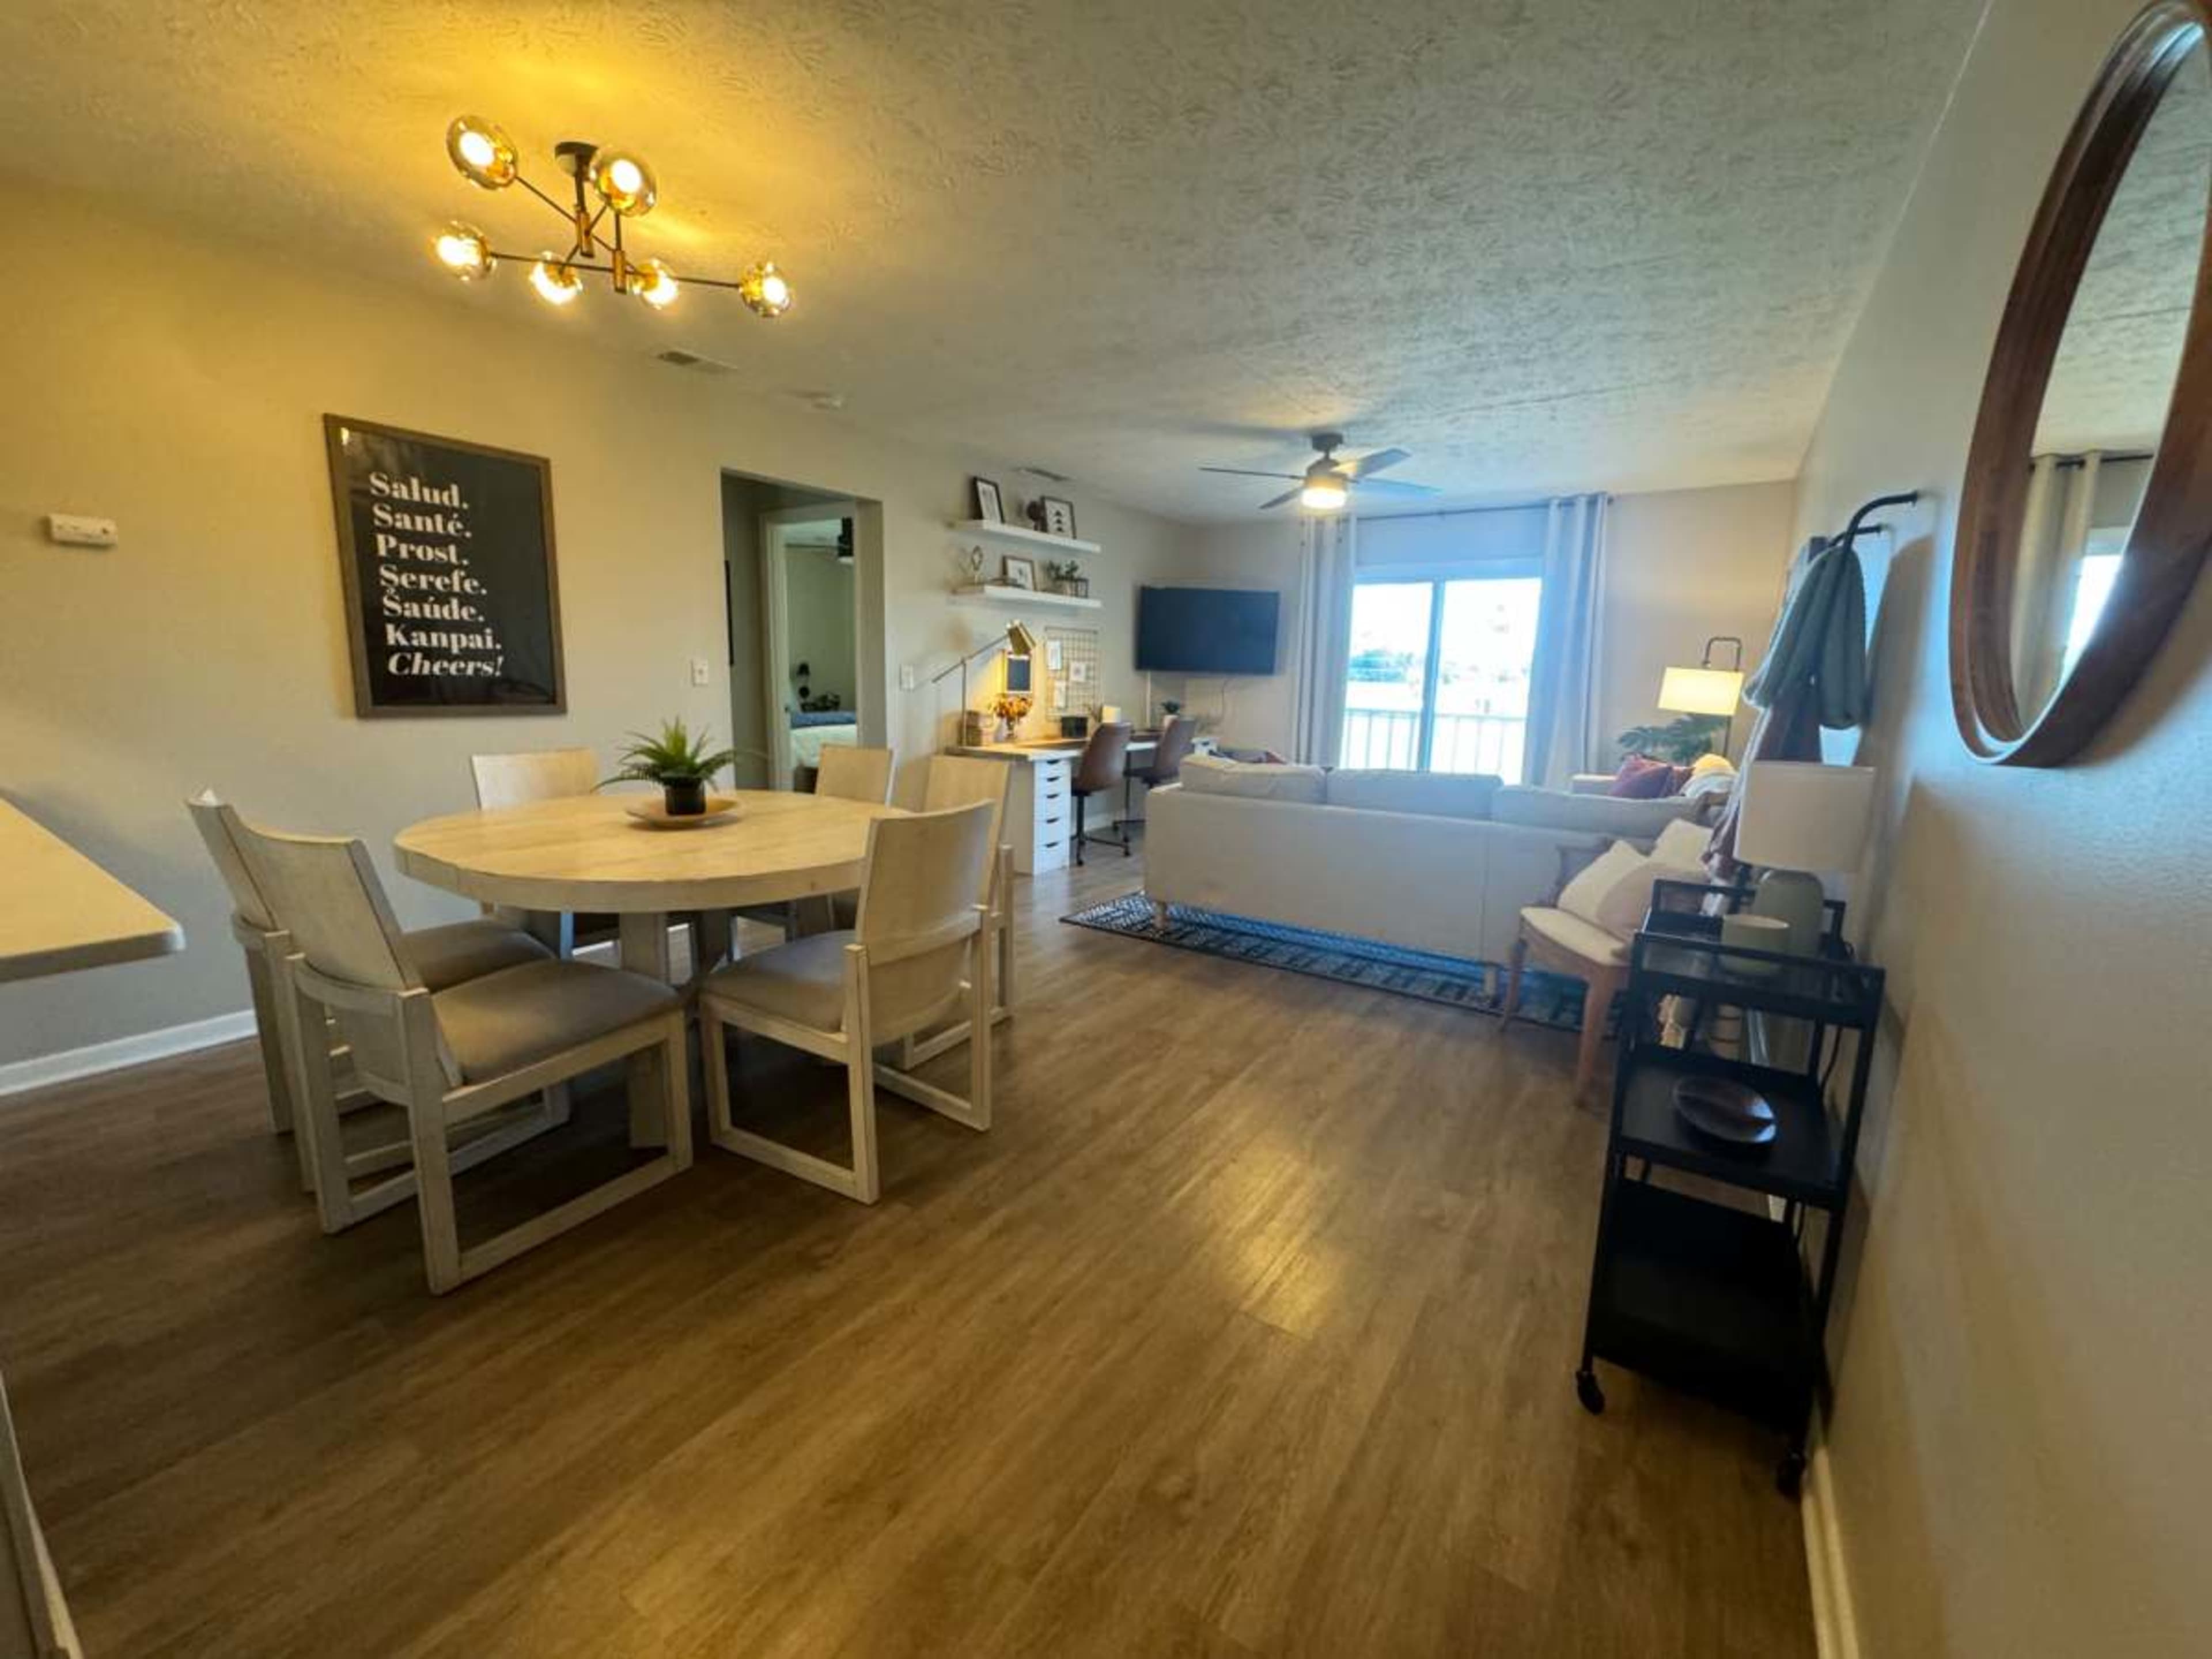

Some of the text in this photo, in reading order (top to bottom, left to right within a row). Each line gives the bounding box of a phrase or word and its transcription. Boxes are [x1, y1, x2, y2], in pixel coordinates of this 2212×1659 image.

[369, 472, 469, 509] Salud.
[373, 502, 472, 538] Santé.
[376, 533, 469, 565] Prost.
[382, 594, 485, 622] Saúde.
[385, 623, 502, 654] Kanpai.
[388, 652, 504, 677] Cheers!
